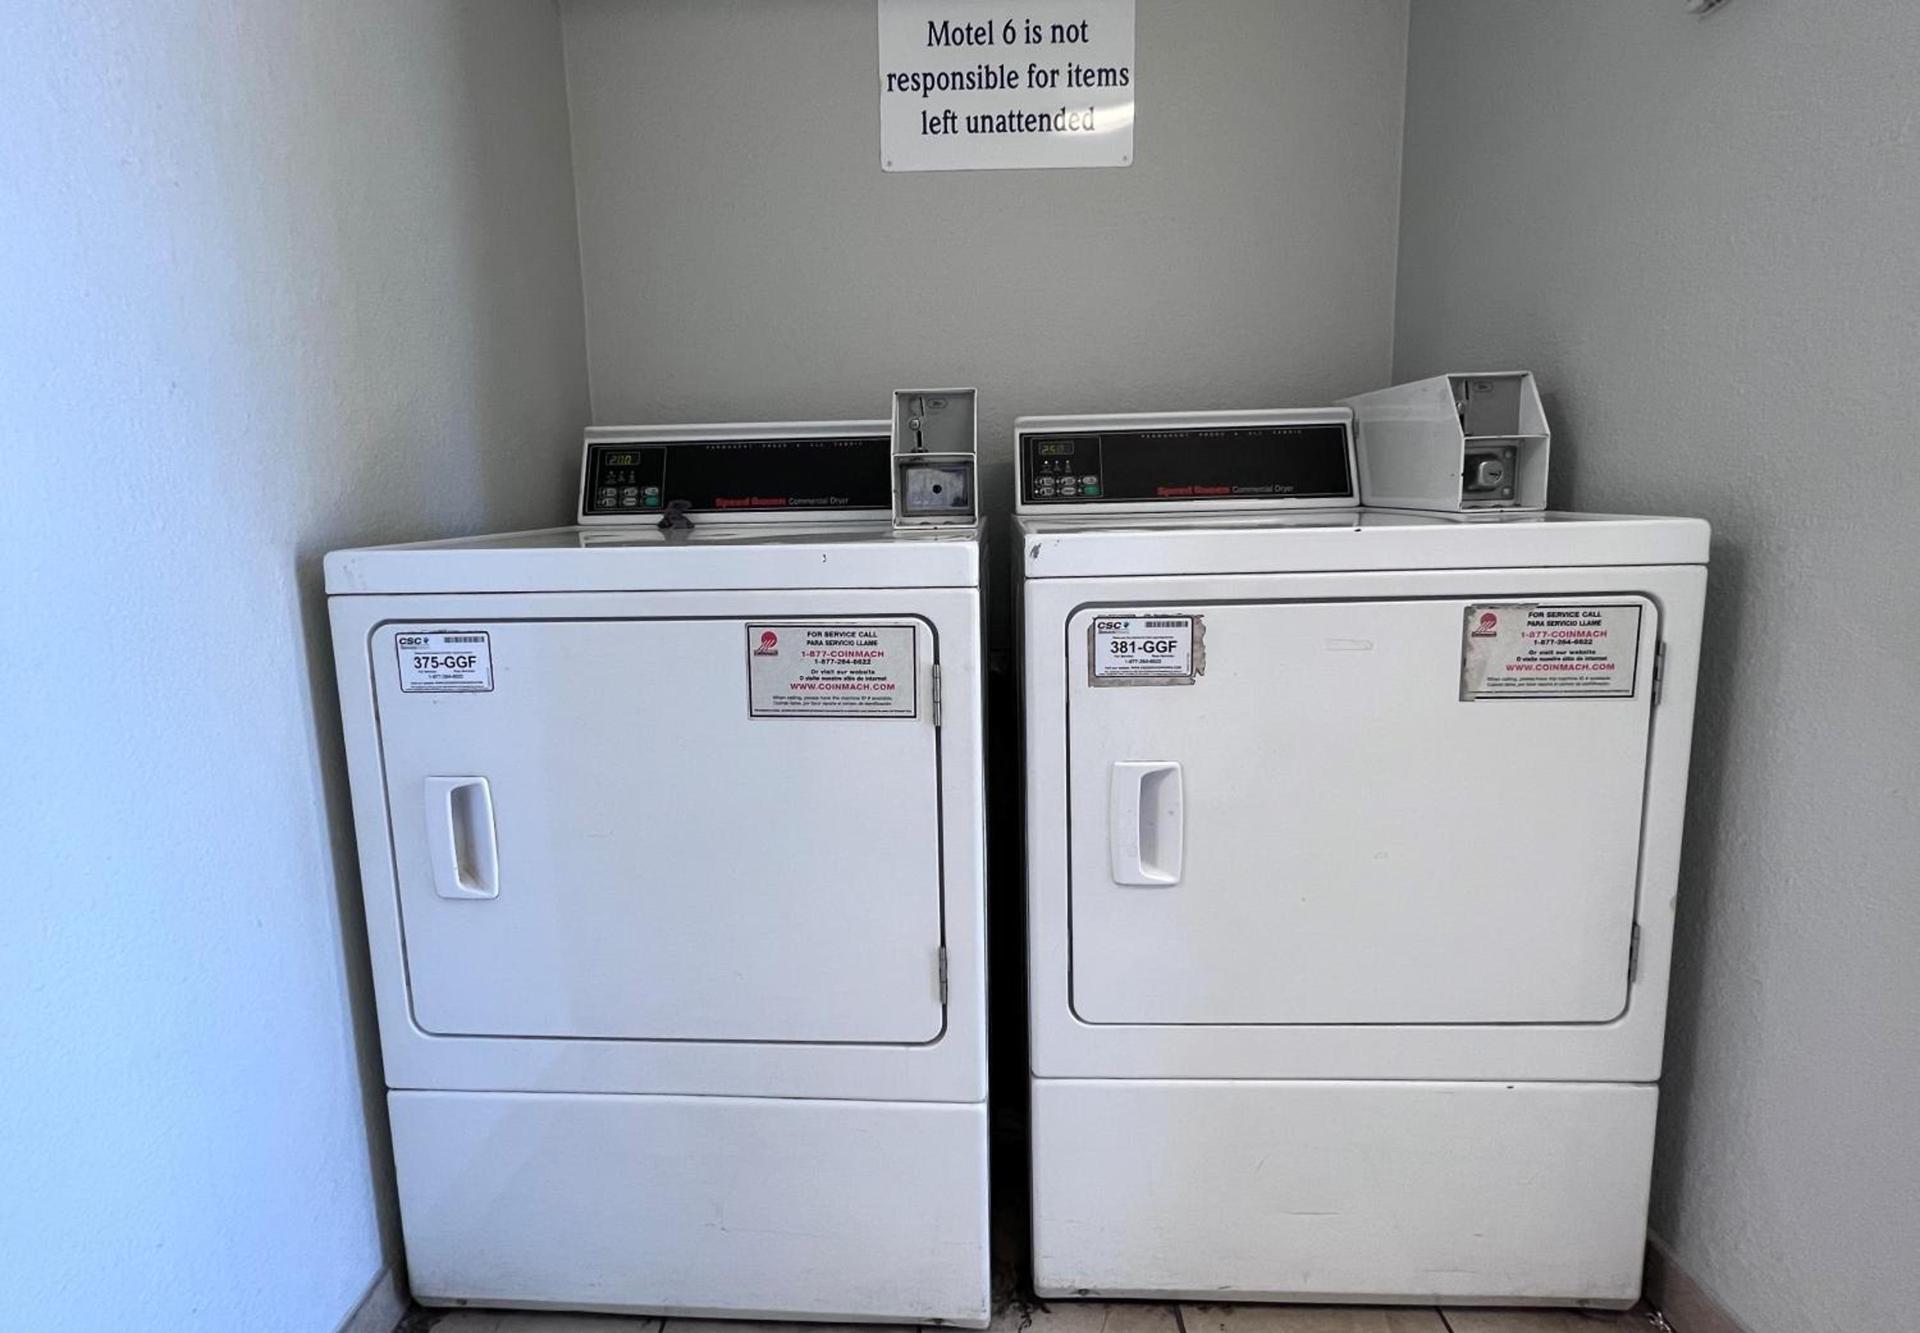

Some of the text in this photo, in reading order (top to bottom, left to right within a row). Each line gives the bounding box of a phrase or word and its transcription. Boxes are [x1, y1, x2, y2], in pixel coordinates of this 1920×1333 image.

[927, 18, 1089, 47] Motel 6 is not
[886, 62, 1130, 98] responsible for items
[921, 107, 1095, 135] left unattended
[1097, 621, 1121, 630] CSC
[1521, 630, 1607, 638] 1-877-COINMACH
[399, 637, 422, 645] CSC
[1110, 640, 1178, 654] 381-GGF
[801, 650, 884, 658] 1-877-COINMACH
[414, 655, 477, 669] 375-GGF
[1505, 663, 1615, 671] WWW.COINMACH.COM
[790, 683, 896, 691] WWW.COINMACH.COM
